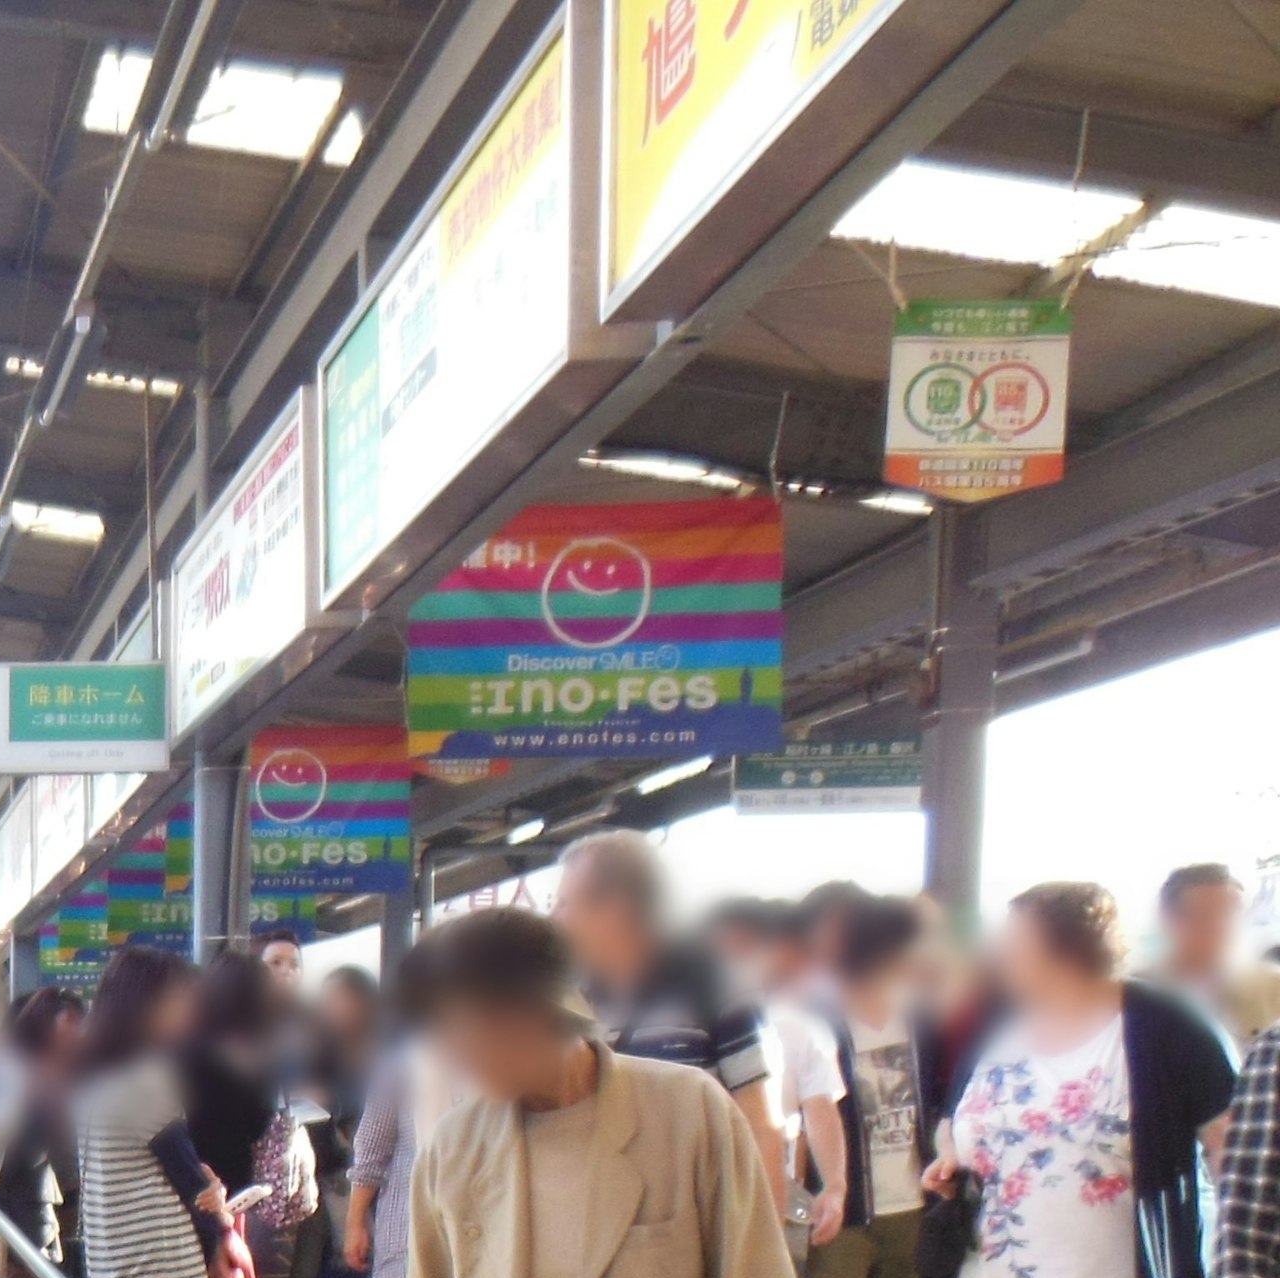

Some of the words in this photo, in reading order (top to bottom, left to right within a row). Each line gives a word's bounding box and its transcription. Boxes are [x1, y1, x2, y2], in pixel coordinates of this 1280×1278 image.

[507, 655, 598, 673] Discover
[29, 684, 145, 706] 降車ホーム
